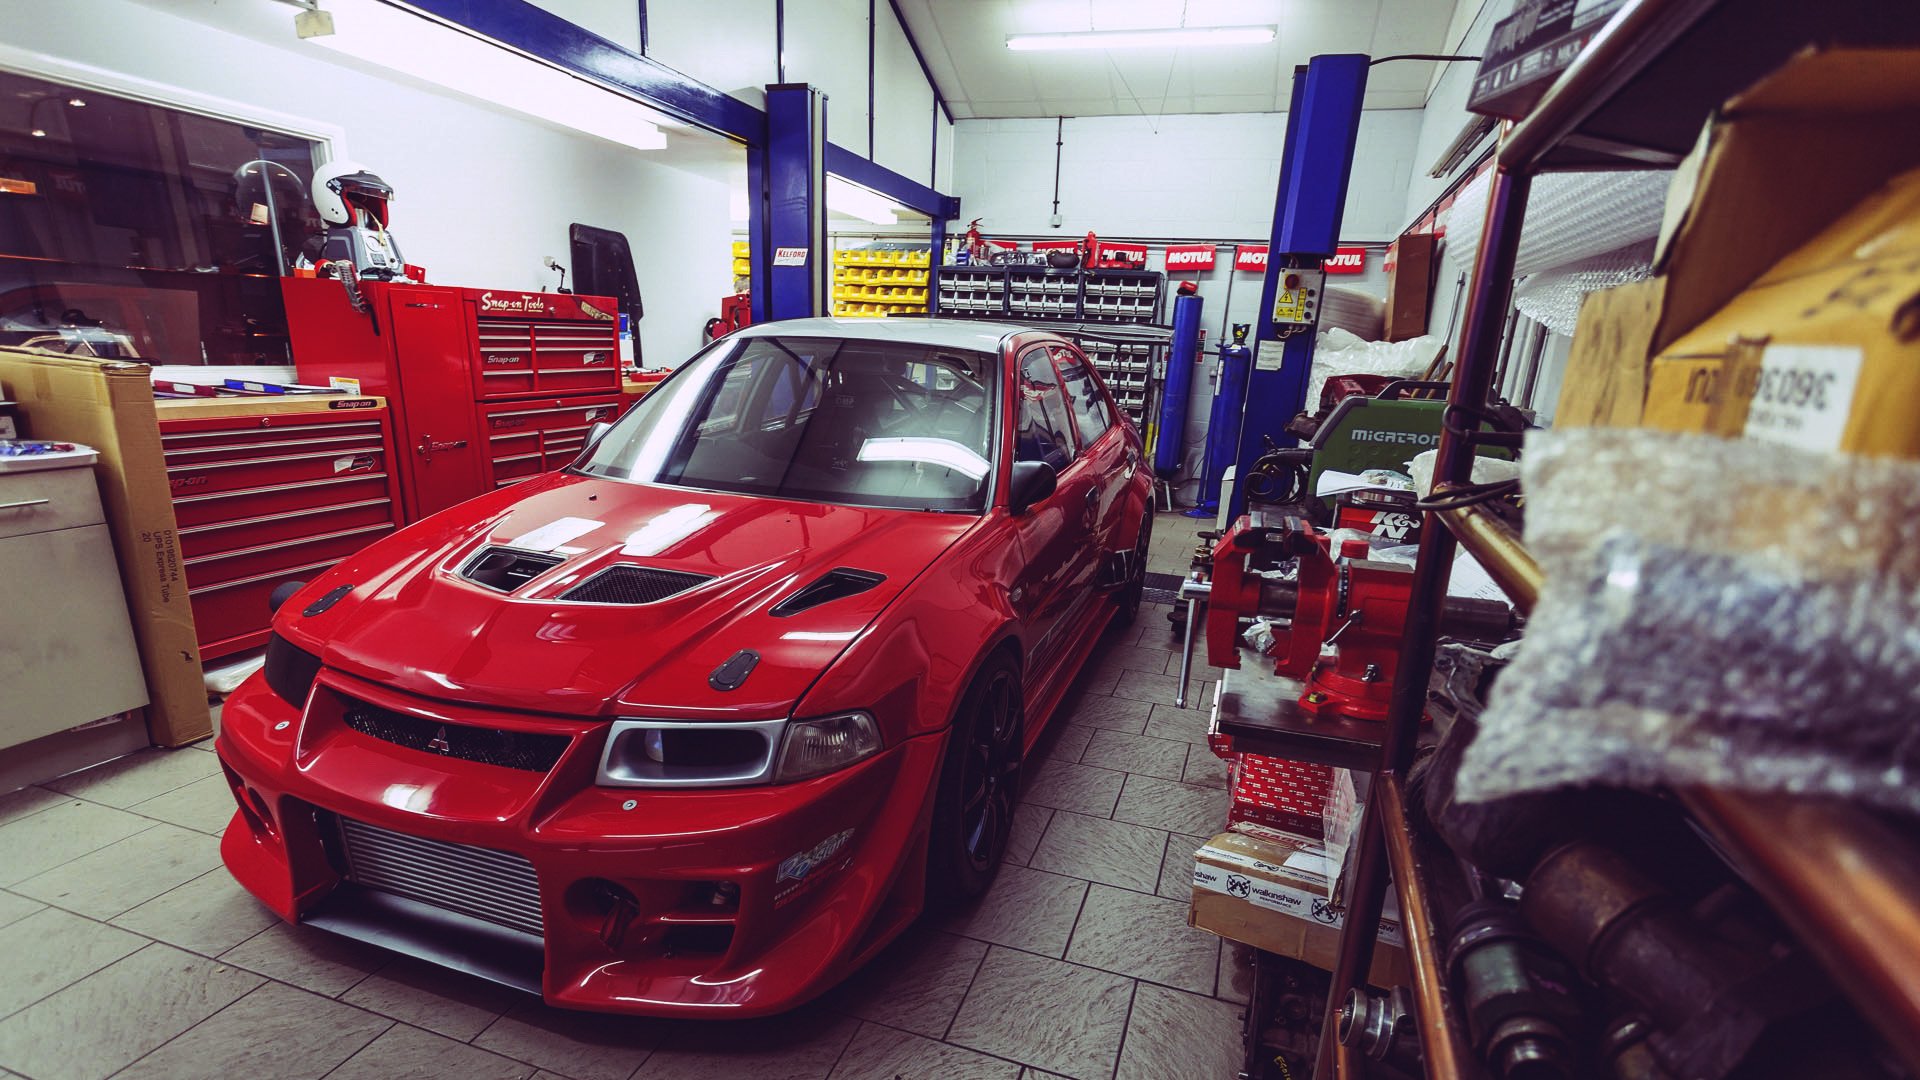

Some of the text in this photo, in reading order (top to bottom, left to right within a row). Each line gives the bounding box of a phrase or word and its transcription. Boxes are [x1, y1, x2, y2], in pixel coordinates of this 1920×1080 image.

[777, 249, 806, 258] KELFORD
[1167, 251, 1213, 264] MOTUL
[1238, 252, 1268, 264] MOT
[1325, 254, 1362, 266] OTUL
[481, 292, 544, 313] Snap-on Tools
[487, 355, 520, 364] Snap-on
[336, 399, 372, 409] Snap-on
[142, 531, 151, 543] 20
[153, 531, 163, 549] UPS
[161, 583, 170, 603] Tube
[1251, 886, 1302, 906] walkinshaw
